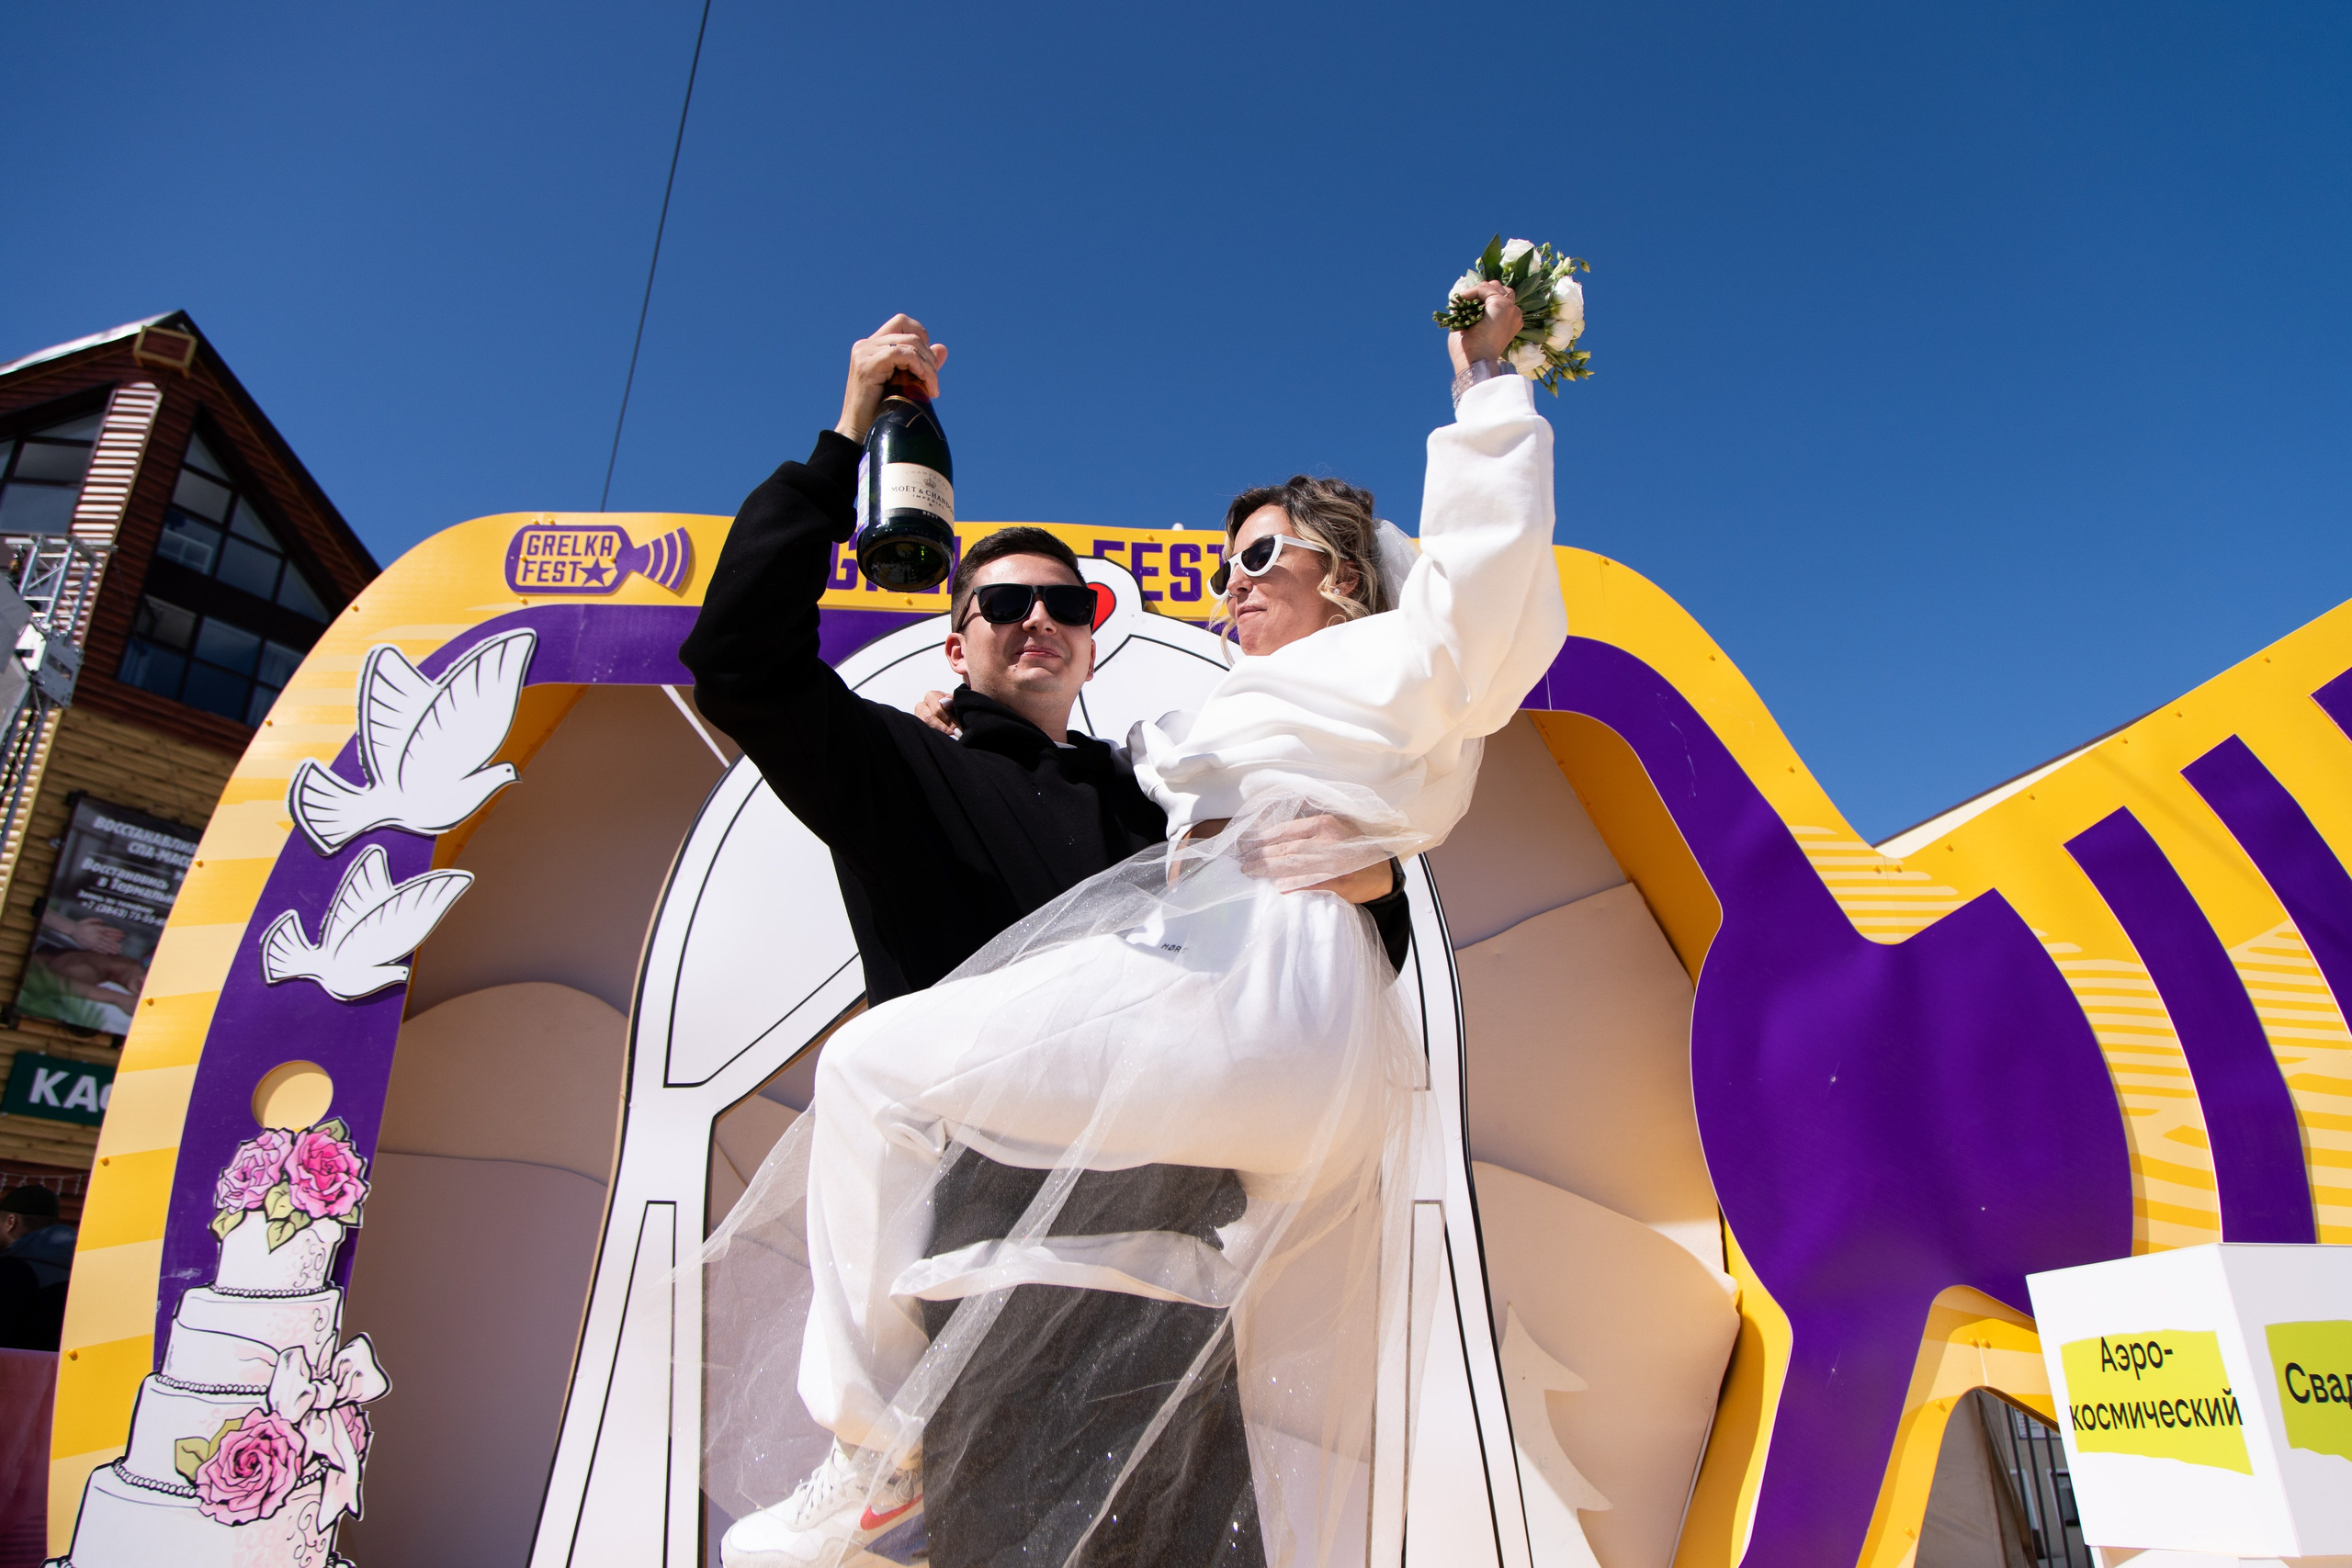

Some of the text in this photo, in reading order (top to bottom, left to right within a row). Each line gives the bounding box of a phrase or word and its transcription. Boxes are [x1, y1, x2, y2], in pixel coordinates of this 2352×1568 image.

[922, 511, 939, 521] BRUT
[526, 535, 615, 557] GRELKA
[522, 560, 582, 582] FEST
[2100, 1336, 2174, 1381] Аэро-
[2069, 1387, 2244, 1432] космический
